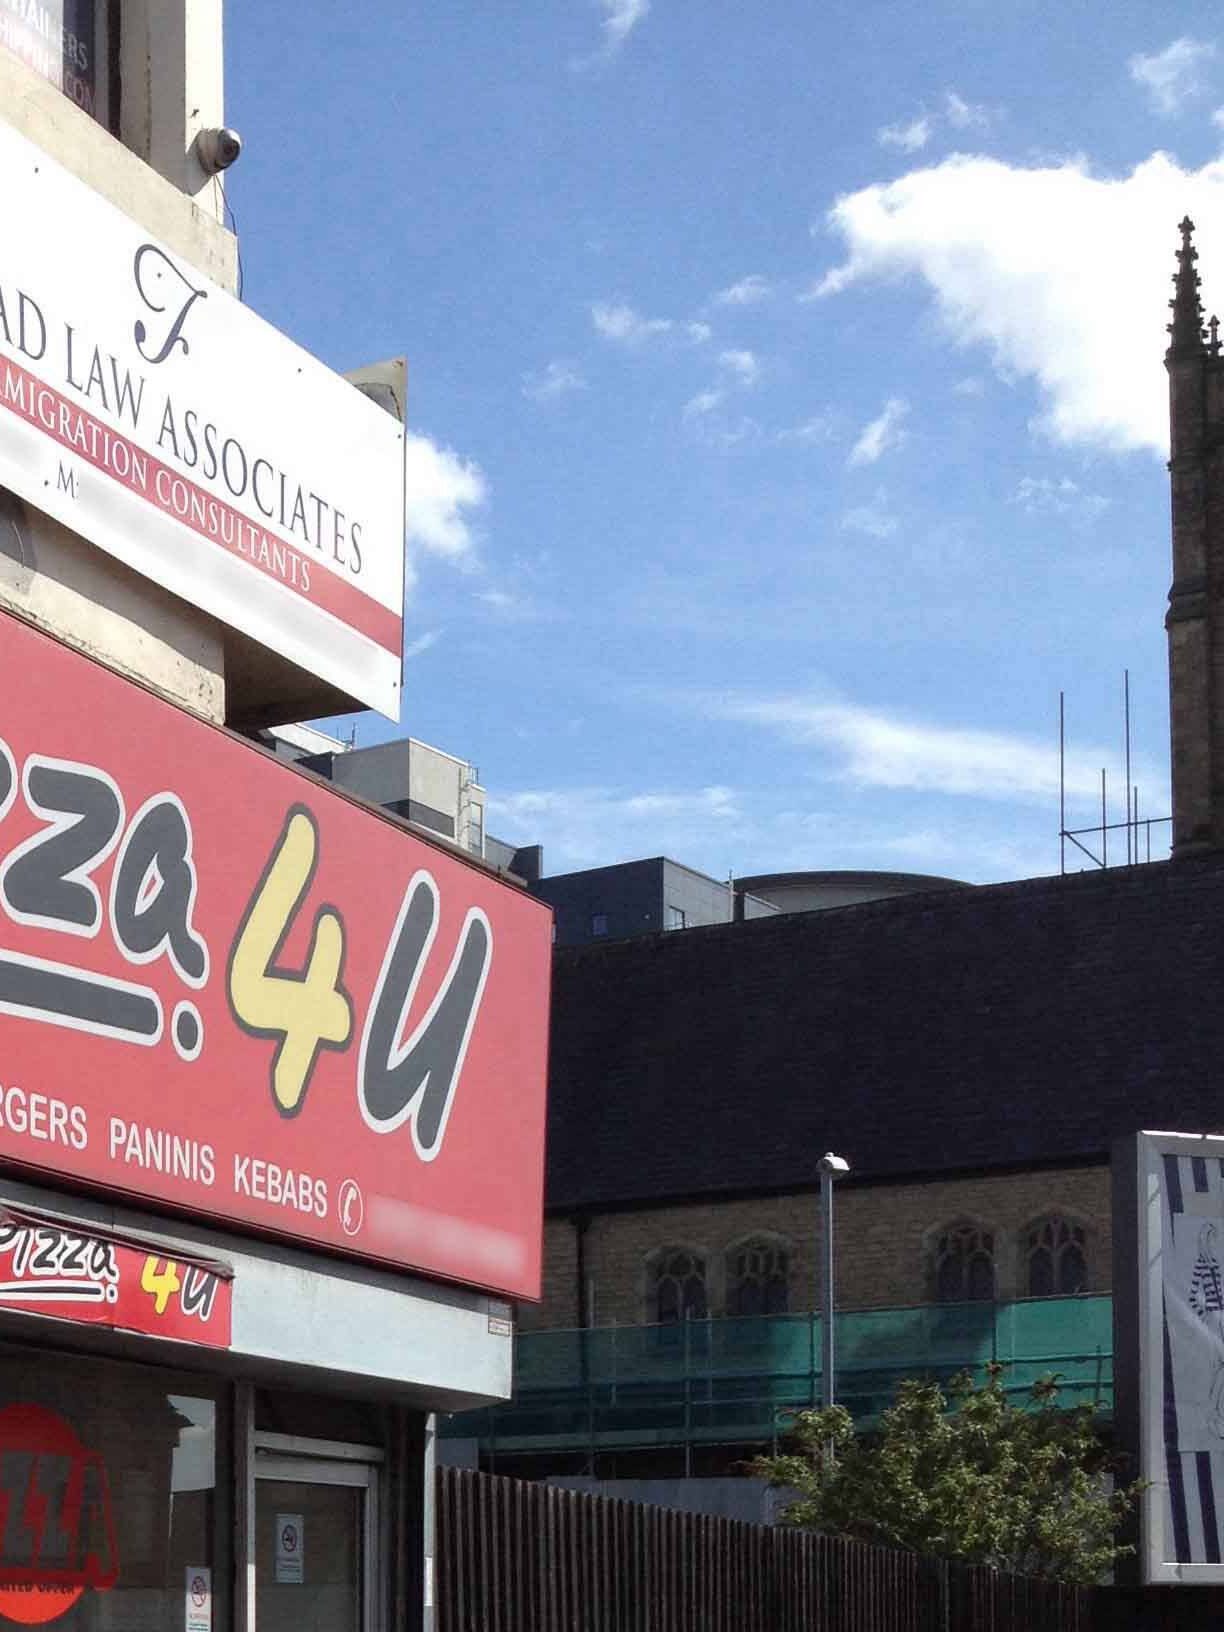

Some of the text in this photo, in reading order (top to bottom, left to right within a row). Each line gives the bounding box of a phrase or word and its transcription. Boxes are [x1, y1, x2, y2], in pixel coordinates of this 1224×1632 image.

[64, 322, 147, 430] LAW
[157, 394, 364, 575] ASSOCIATES
[155, 470, 311, 592] CONSULTANTS
[110, 1117, 216, 1185] PANINIS
[234, 1154, 328, 1218] KEBABS
